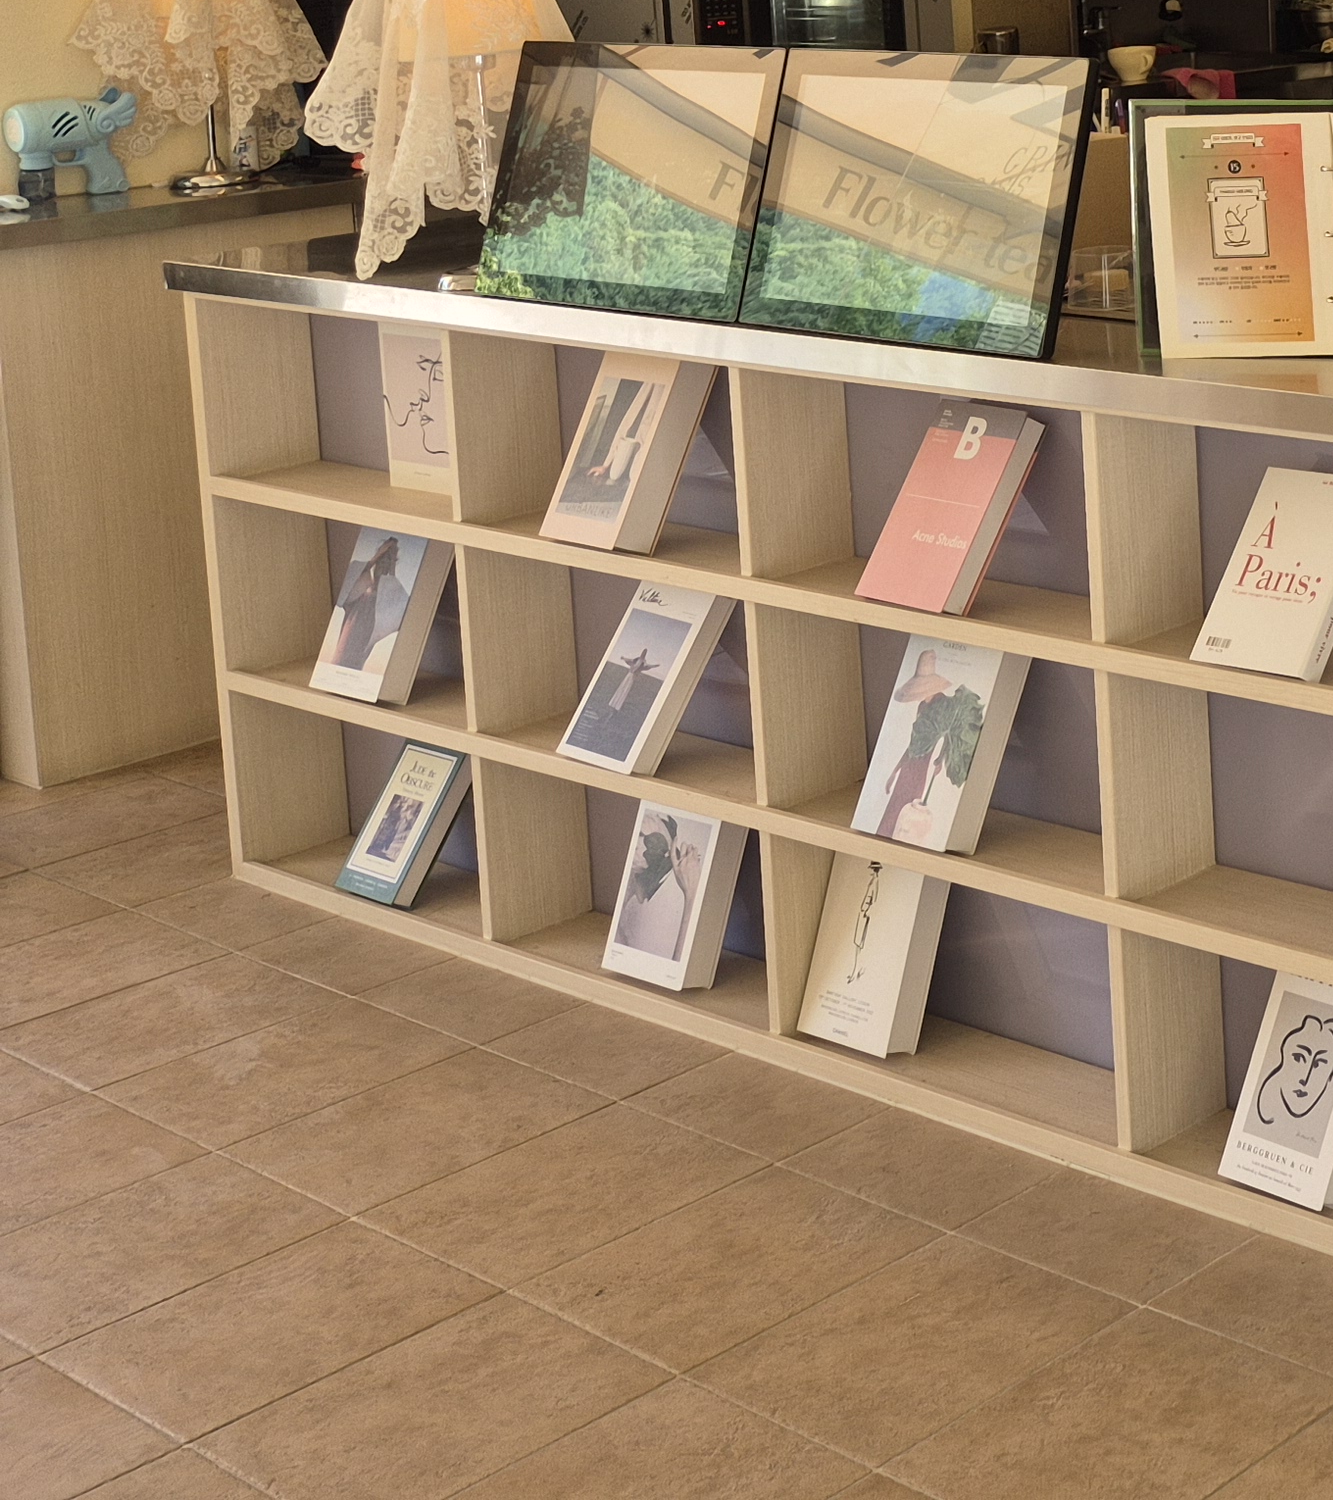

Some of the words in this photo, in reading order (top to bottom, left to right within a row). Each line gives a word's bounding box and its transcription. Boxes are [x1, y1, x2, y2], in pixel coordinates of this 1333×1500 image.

[822, 164, 978, 252] Flower
[953, 416, 988, 460] B
[912, 529, 935, 543] Acne
[938, 532, 968, 550] Studios
[1236, 1139, 1288, 1165] BERGGRUEN
[1299, 1163, 1314, 1176] CIE
